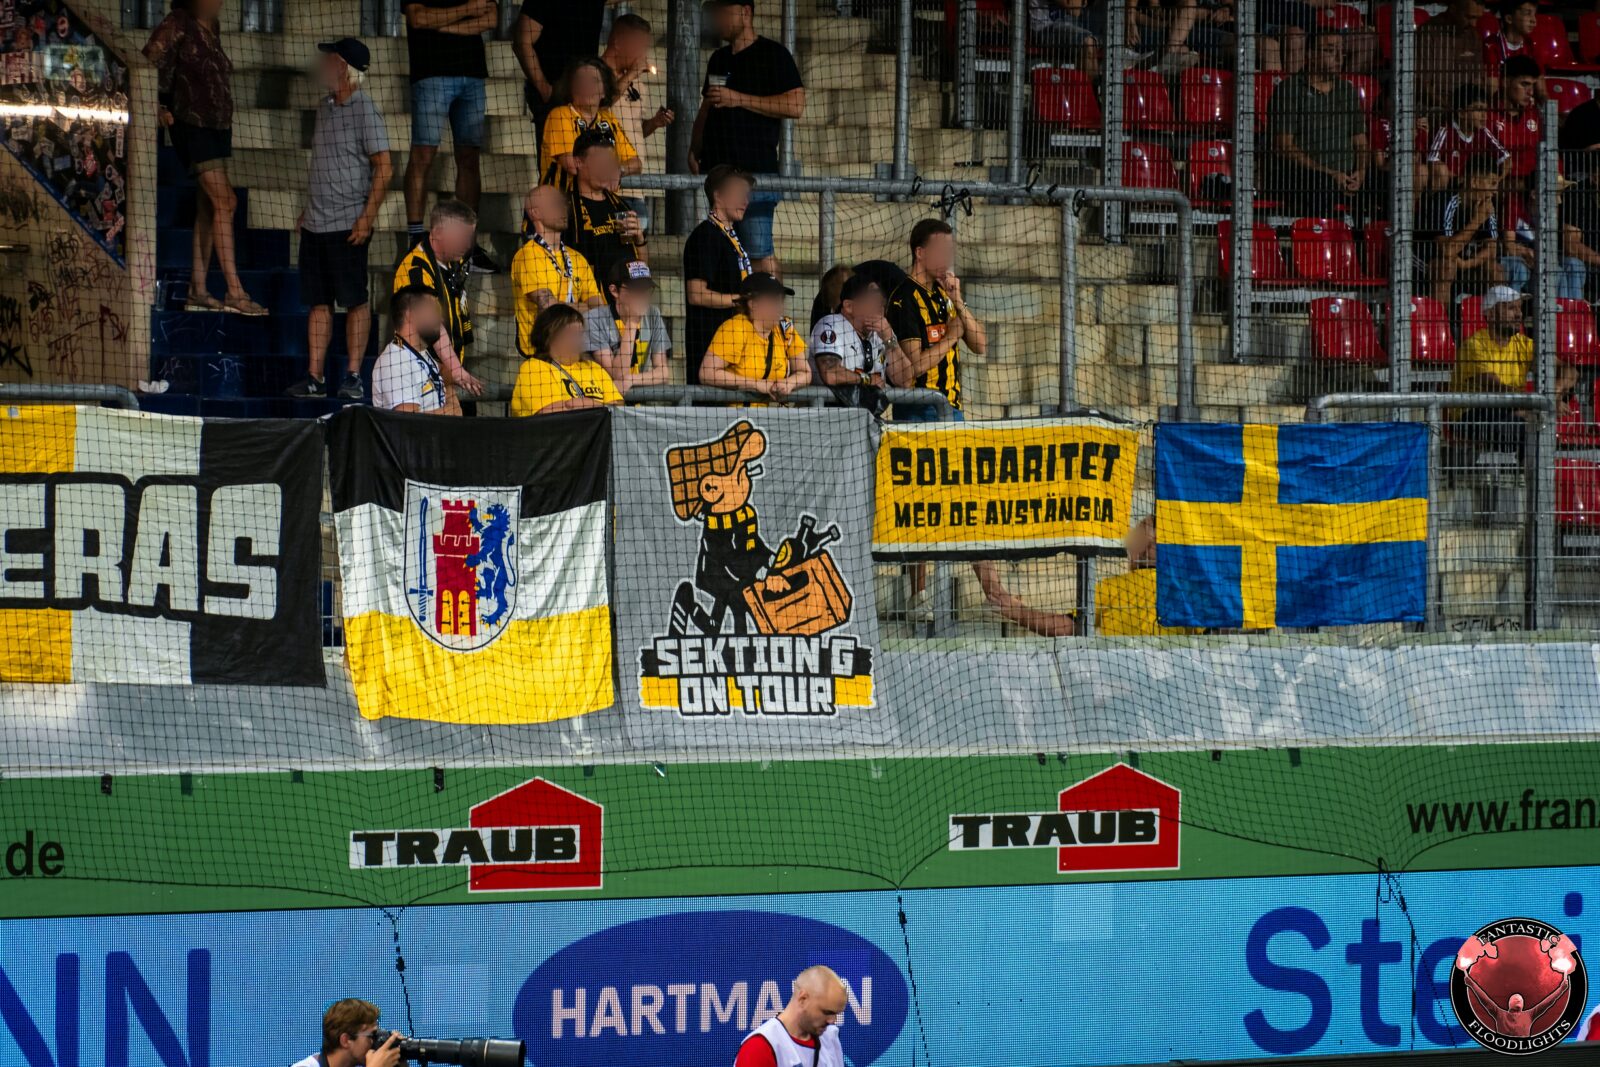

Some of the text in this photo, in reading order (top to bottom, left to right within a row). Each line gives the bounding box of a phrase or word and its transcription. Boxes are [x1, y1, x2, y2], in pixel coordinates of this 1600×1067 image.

[890, 441, 1121, 486] SOLIDARITET
[894, 492, 1114, 528] MED DE AVSTÄNGDA
[0, 480, 282, 620] ERAS
[656, 636, 855, 677] SEKTION G
[680, 674, 837, 714] ON TOUR
[951, 811, 1157, 848] TRAUB
[1406, 788, 1600, 834] www.fran
[5, 828, 65, 877] de
[352, 827, 577, 866] TRAUB
[551, 976, 872, 1039] HARTMAN
